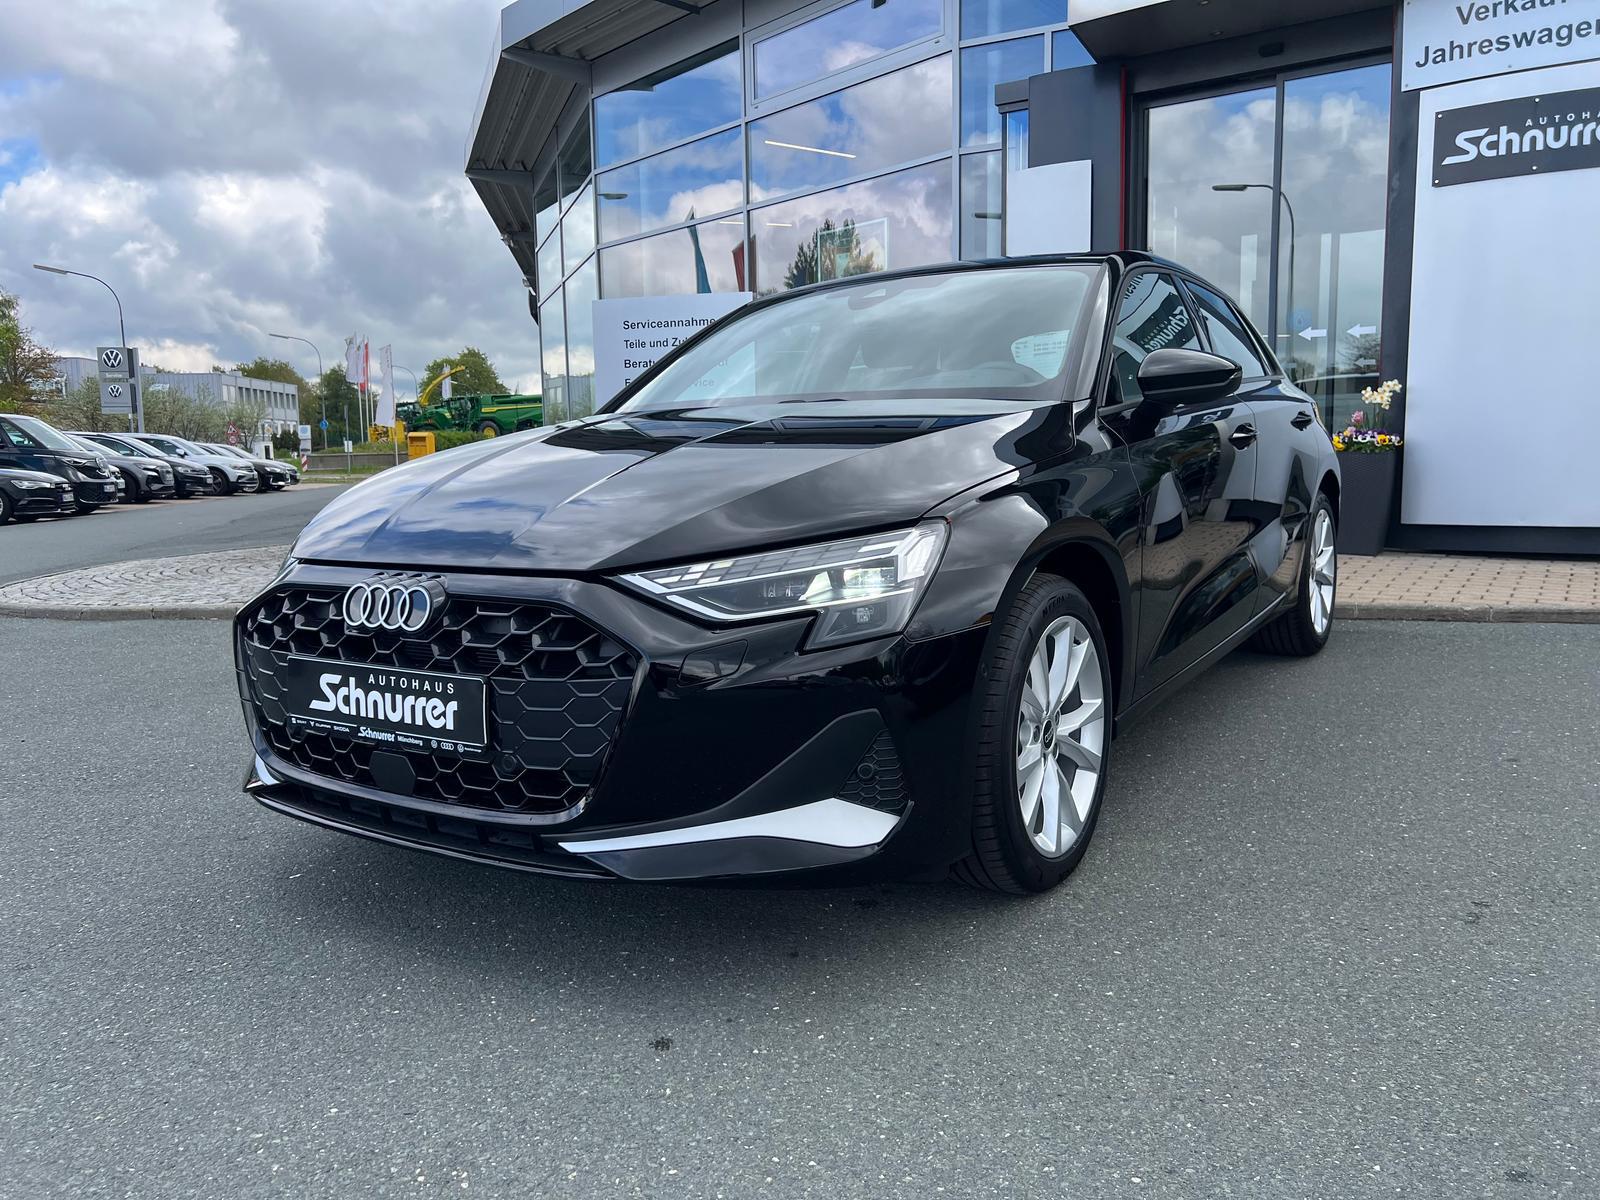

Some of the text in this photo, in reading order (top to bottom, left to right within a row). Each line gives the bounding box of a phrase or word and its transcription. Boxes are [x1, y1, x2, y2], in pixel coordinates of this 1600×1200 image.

[1456, 0, 1567, 25] Verkau
[624, 339, 646, 349] Teile
[649, 337, 669, 348] und
[368, 673, 454, 694] AUTOHAUS
[309, 673, 458, 730] Schnurrer
[358, 726, 395, 742] Schnurrer
